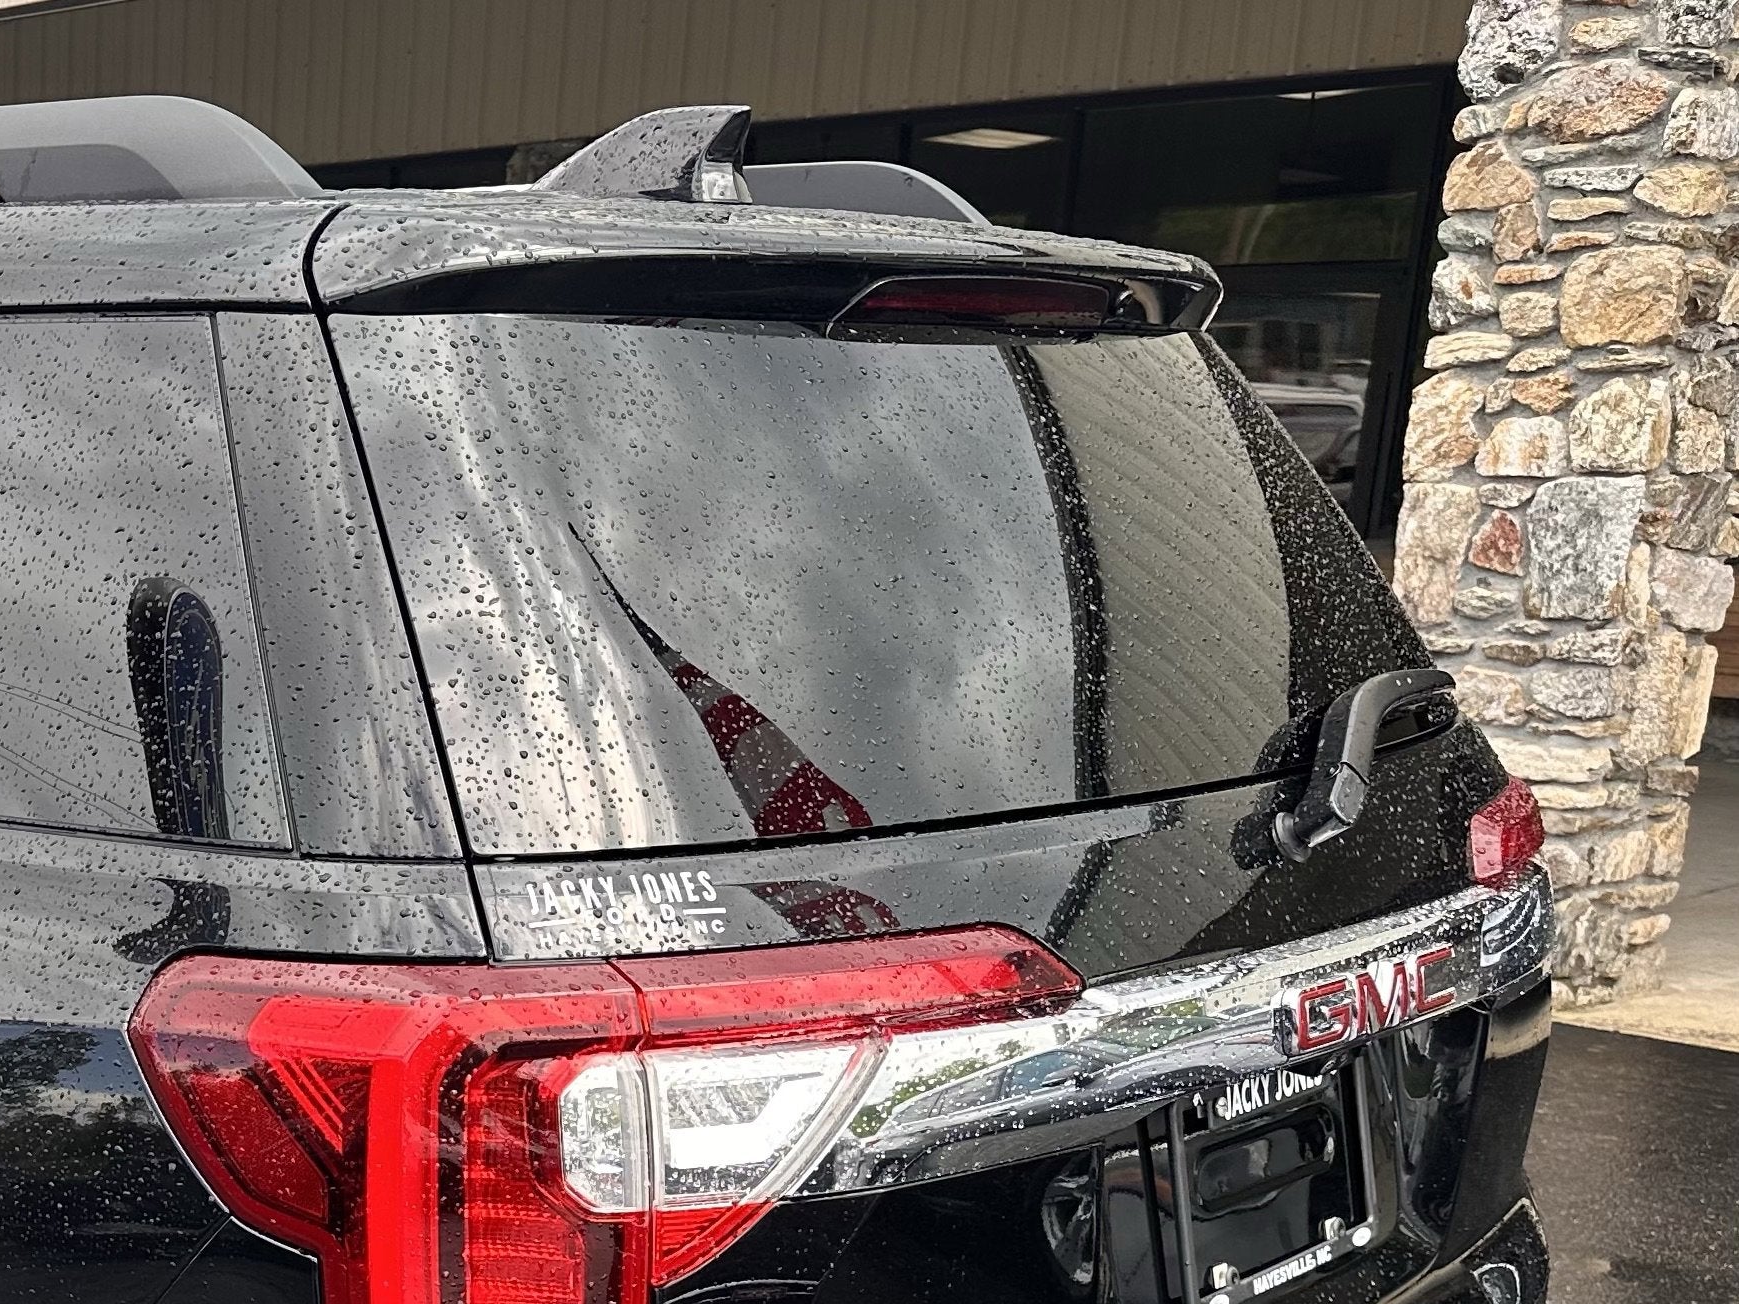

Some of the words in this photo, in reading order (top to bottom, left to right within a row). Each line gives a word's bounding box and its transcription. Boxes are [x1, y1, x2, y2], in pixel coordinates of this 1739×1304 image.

[525, 876, 614, 916] JACKY
[629, 870, 718, 906] JONES
[581, 904, 676, 926] FORD
[694, 919, 726, 934] NC
[1296, 943, 1457, 1051] GMC
[1225, 1074, 1270, 1121] JACKY
[1316, 1245, 1332, 1266] NC
